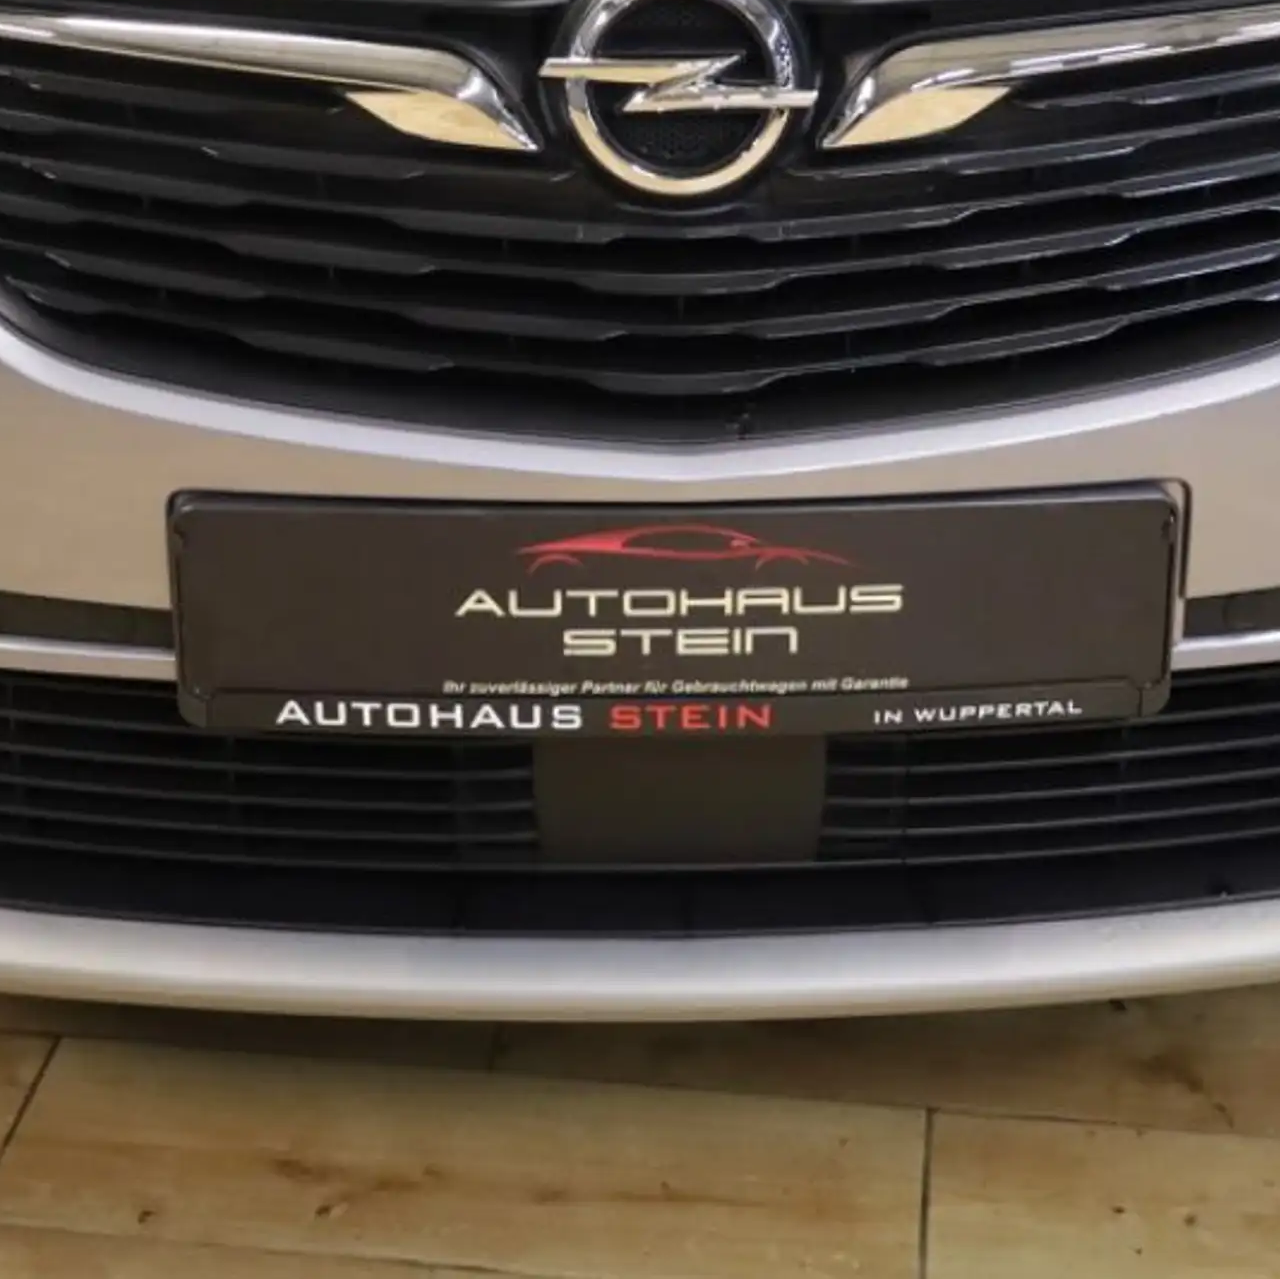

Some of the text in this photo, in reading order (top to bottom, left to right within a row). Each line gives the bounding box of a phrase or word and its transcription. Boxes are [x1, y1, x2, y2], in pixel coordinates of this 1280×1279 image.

[455, 584, 904, 617] AUTOHAUS
[563, 627, 798, 656] STEIN
[443, 679, 465, 694] Ihr
[581, 679, 641, 695] Partner
[644, 678, 669, 695] für
[672, 678, 807, 695] Gebrauchtwagen
[811, 678, 838, 691] mit
[841, 677, 909, 691] Garantie
[275, 699, 1083, 730] AUTOHAUS STEIN IN WUPPERTAL
